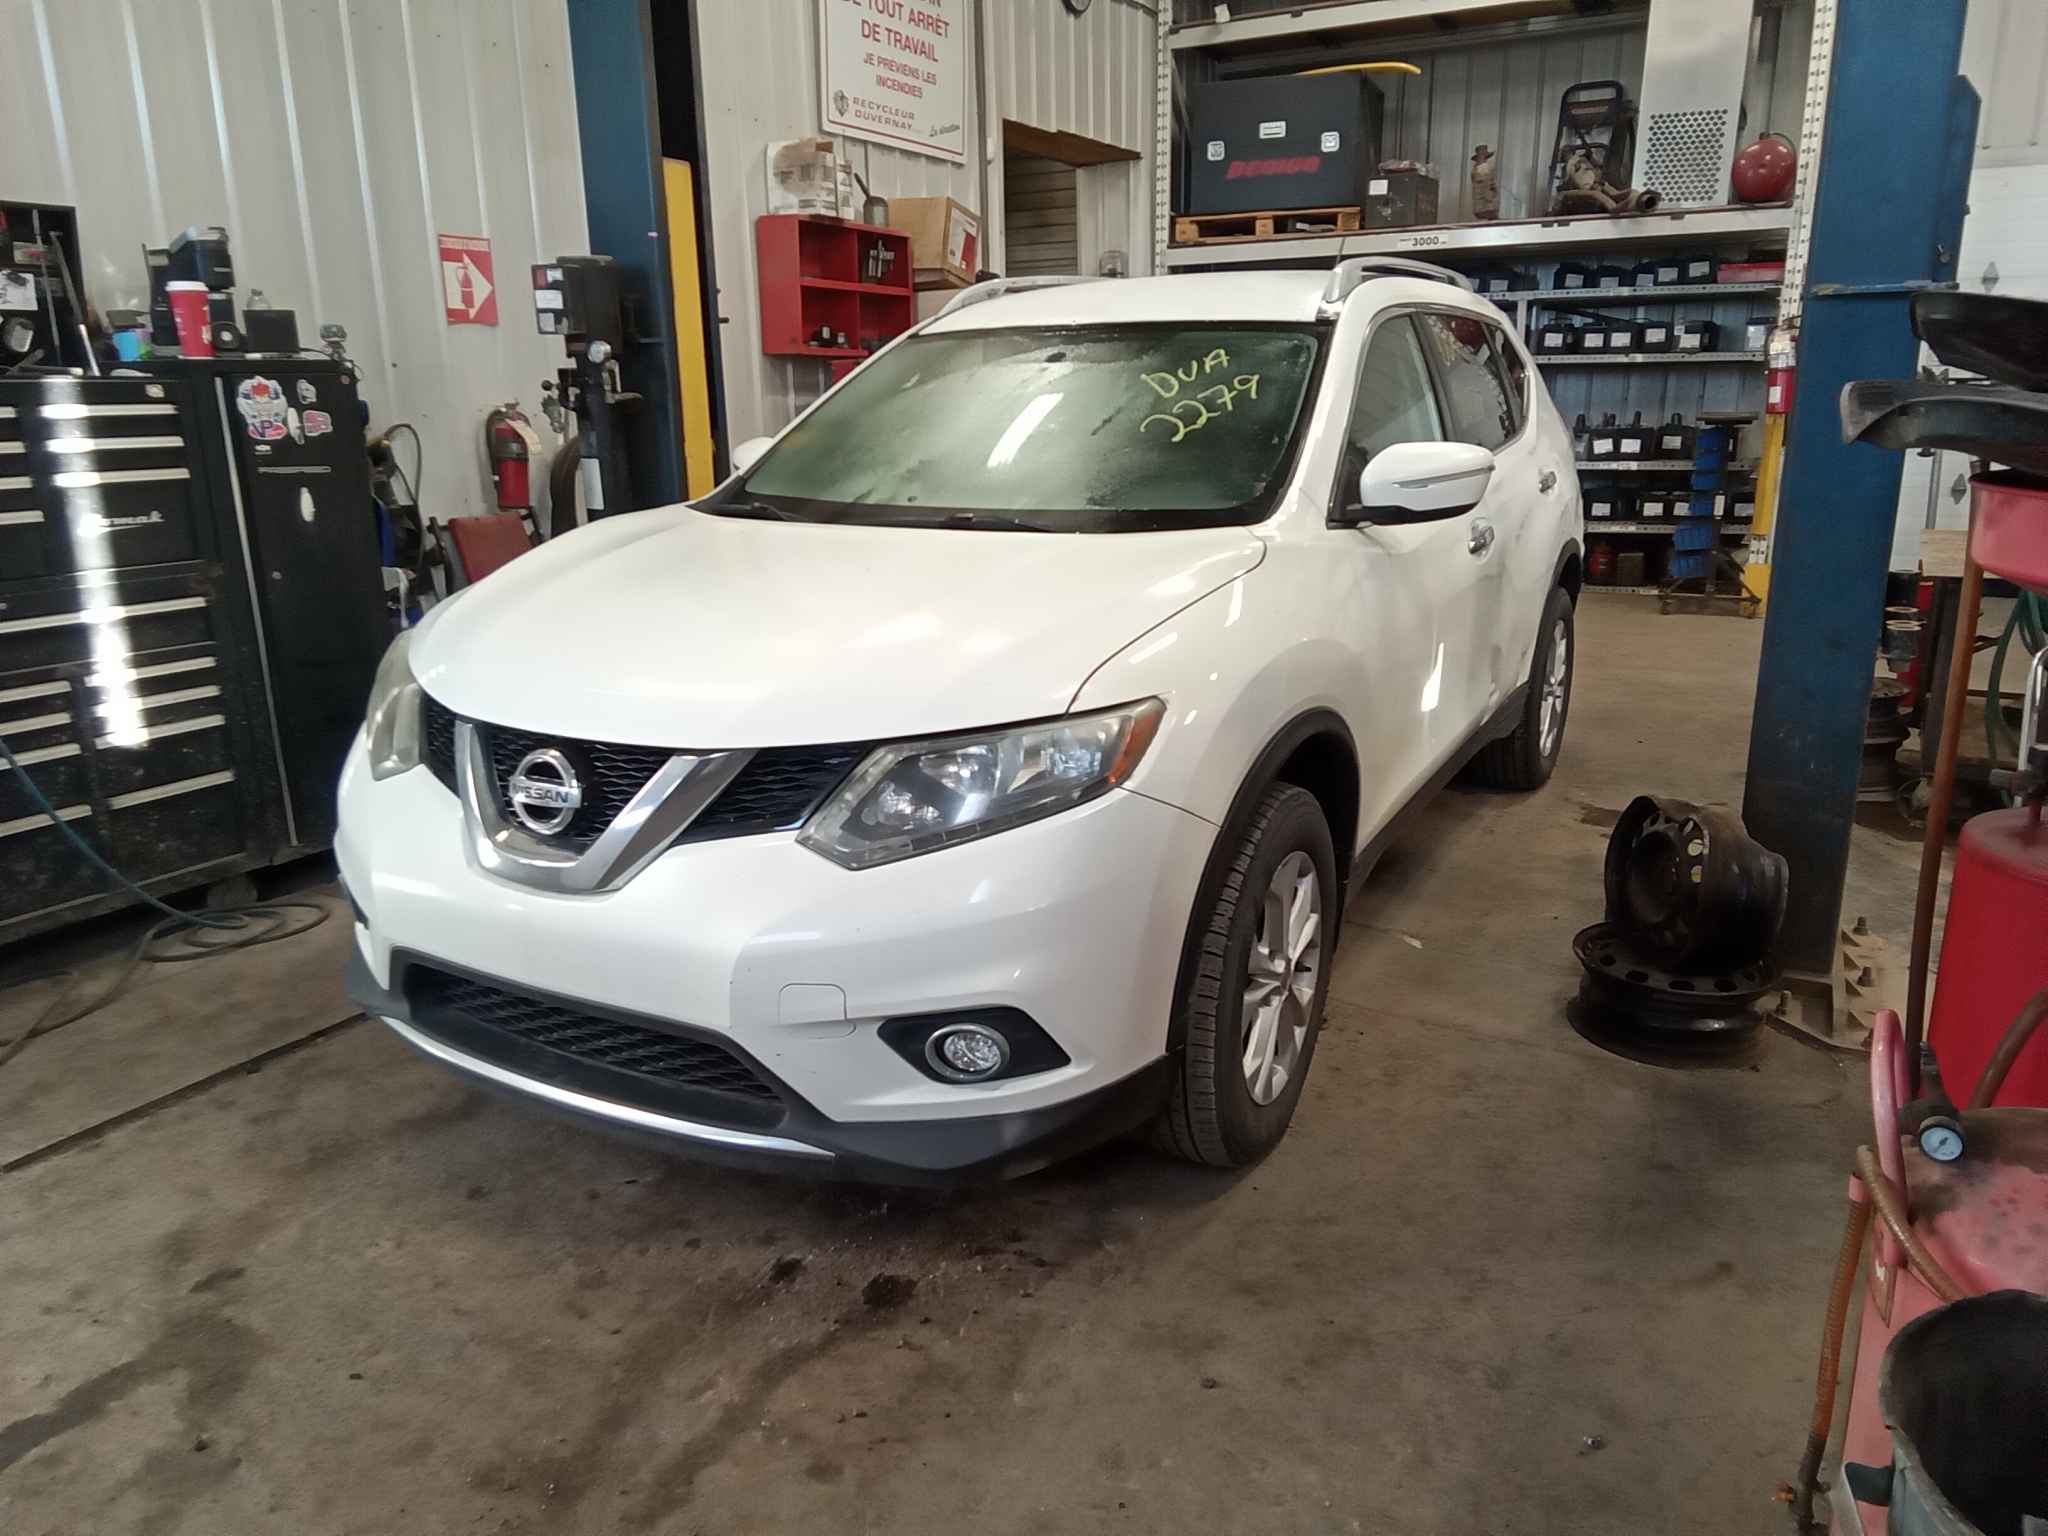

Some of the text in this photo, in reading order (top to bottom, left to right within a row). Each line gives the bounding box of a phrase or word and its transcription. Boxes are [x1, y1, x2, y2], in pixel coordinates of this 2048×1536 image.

[908, 8, 950, 38] ARRÊT
[861, 19, 939, 62] DE TRAVAIL
[864, 52, 875, 66] JE
[922, 70, 937, 85] LES
[876, 74, 923, 98] INCENDIES
[852, 96, 915, 120] RECYCLEUR
[1412, 236, 1440, 247] 3000
[1140, 374, 1260, 442] 2279
